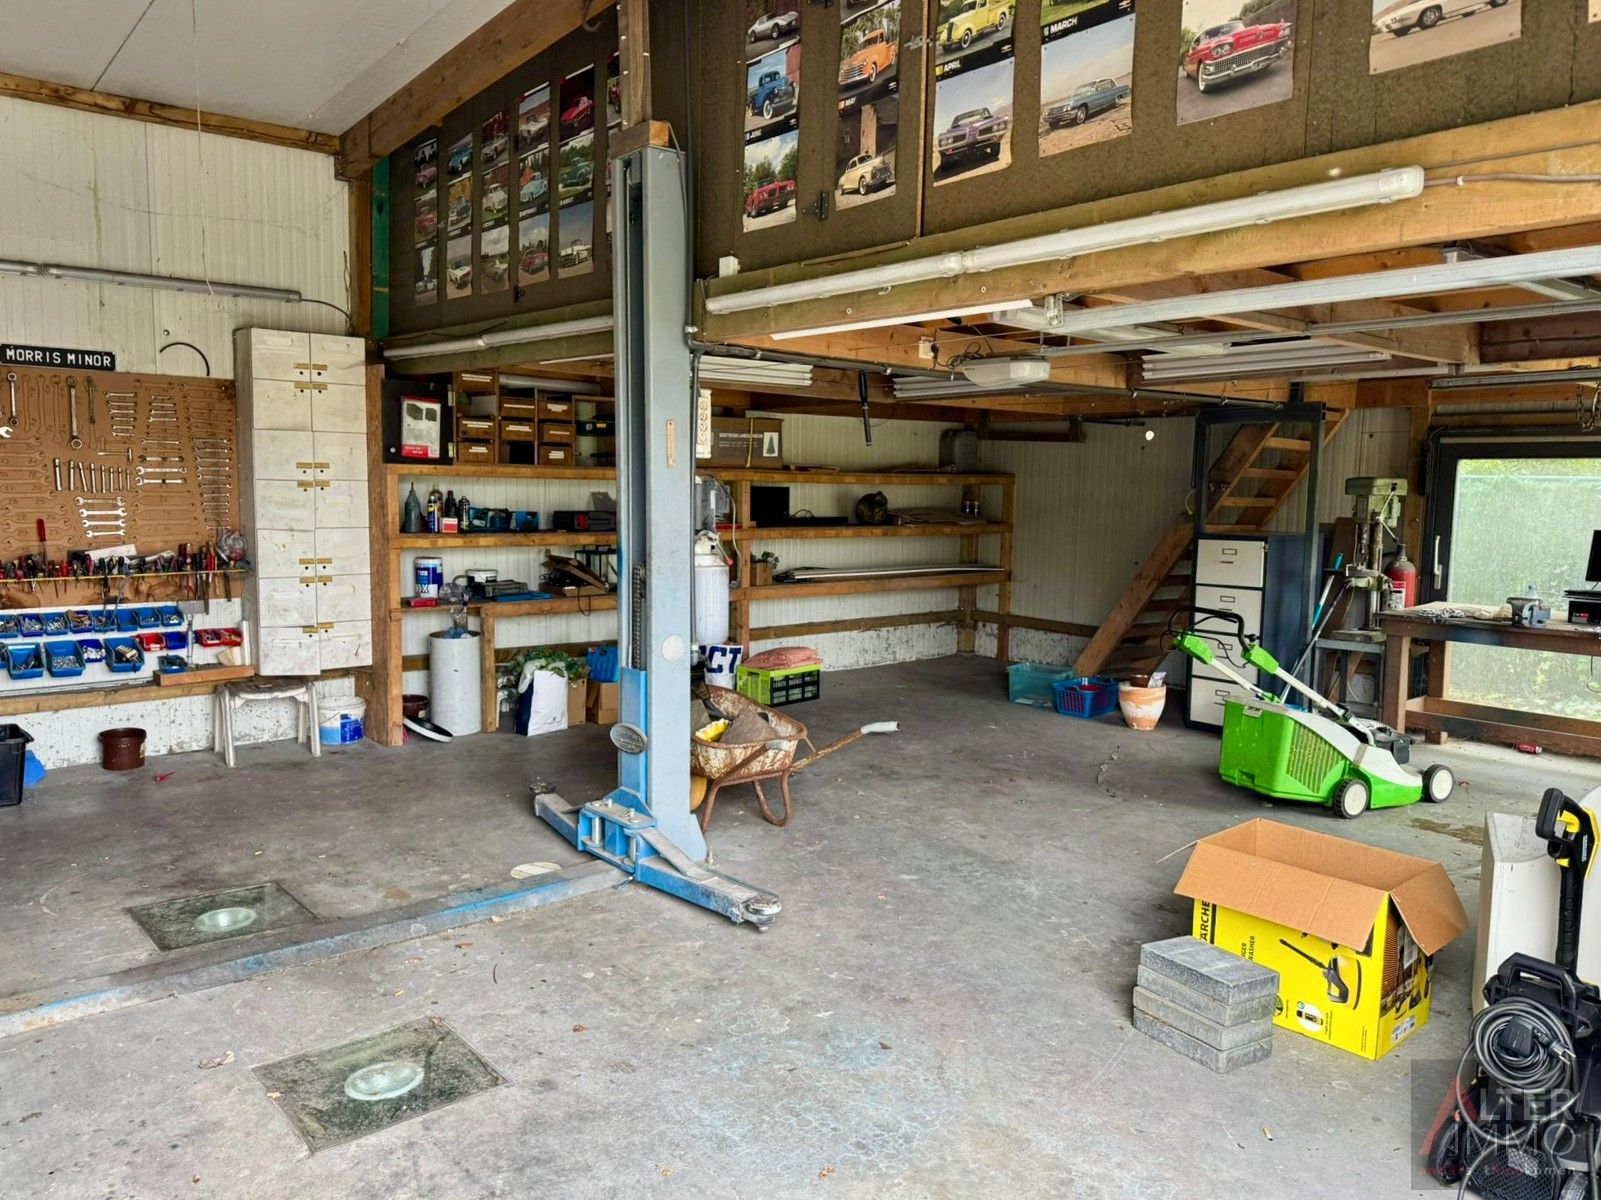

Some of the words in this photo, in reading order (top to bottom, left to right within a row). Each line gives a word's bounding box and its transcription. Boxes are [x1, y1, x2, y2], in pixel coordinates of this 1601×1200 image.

[1050, 16, 1078, 34] MARCH
[943, 60, 961, 72] APRIL
[6, 348, 61, 364] MORRIS
[67, 353, 111, 367] MINOR
